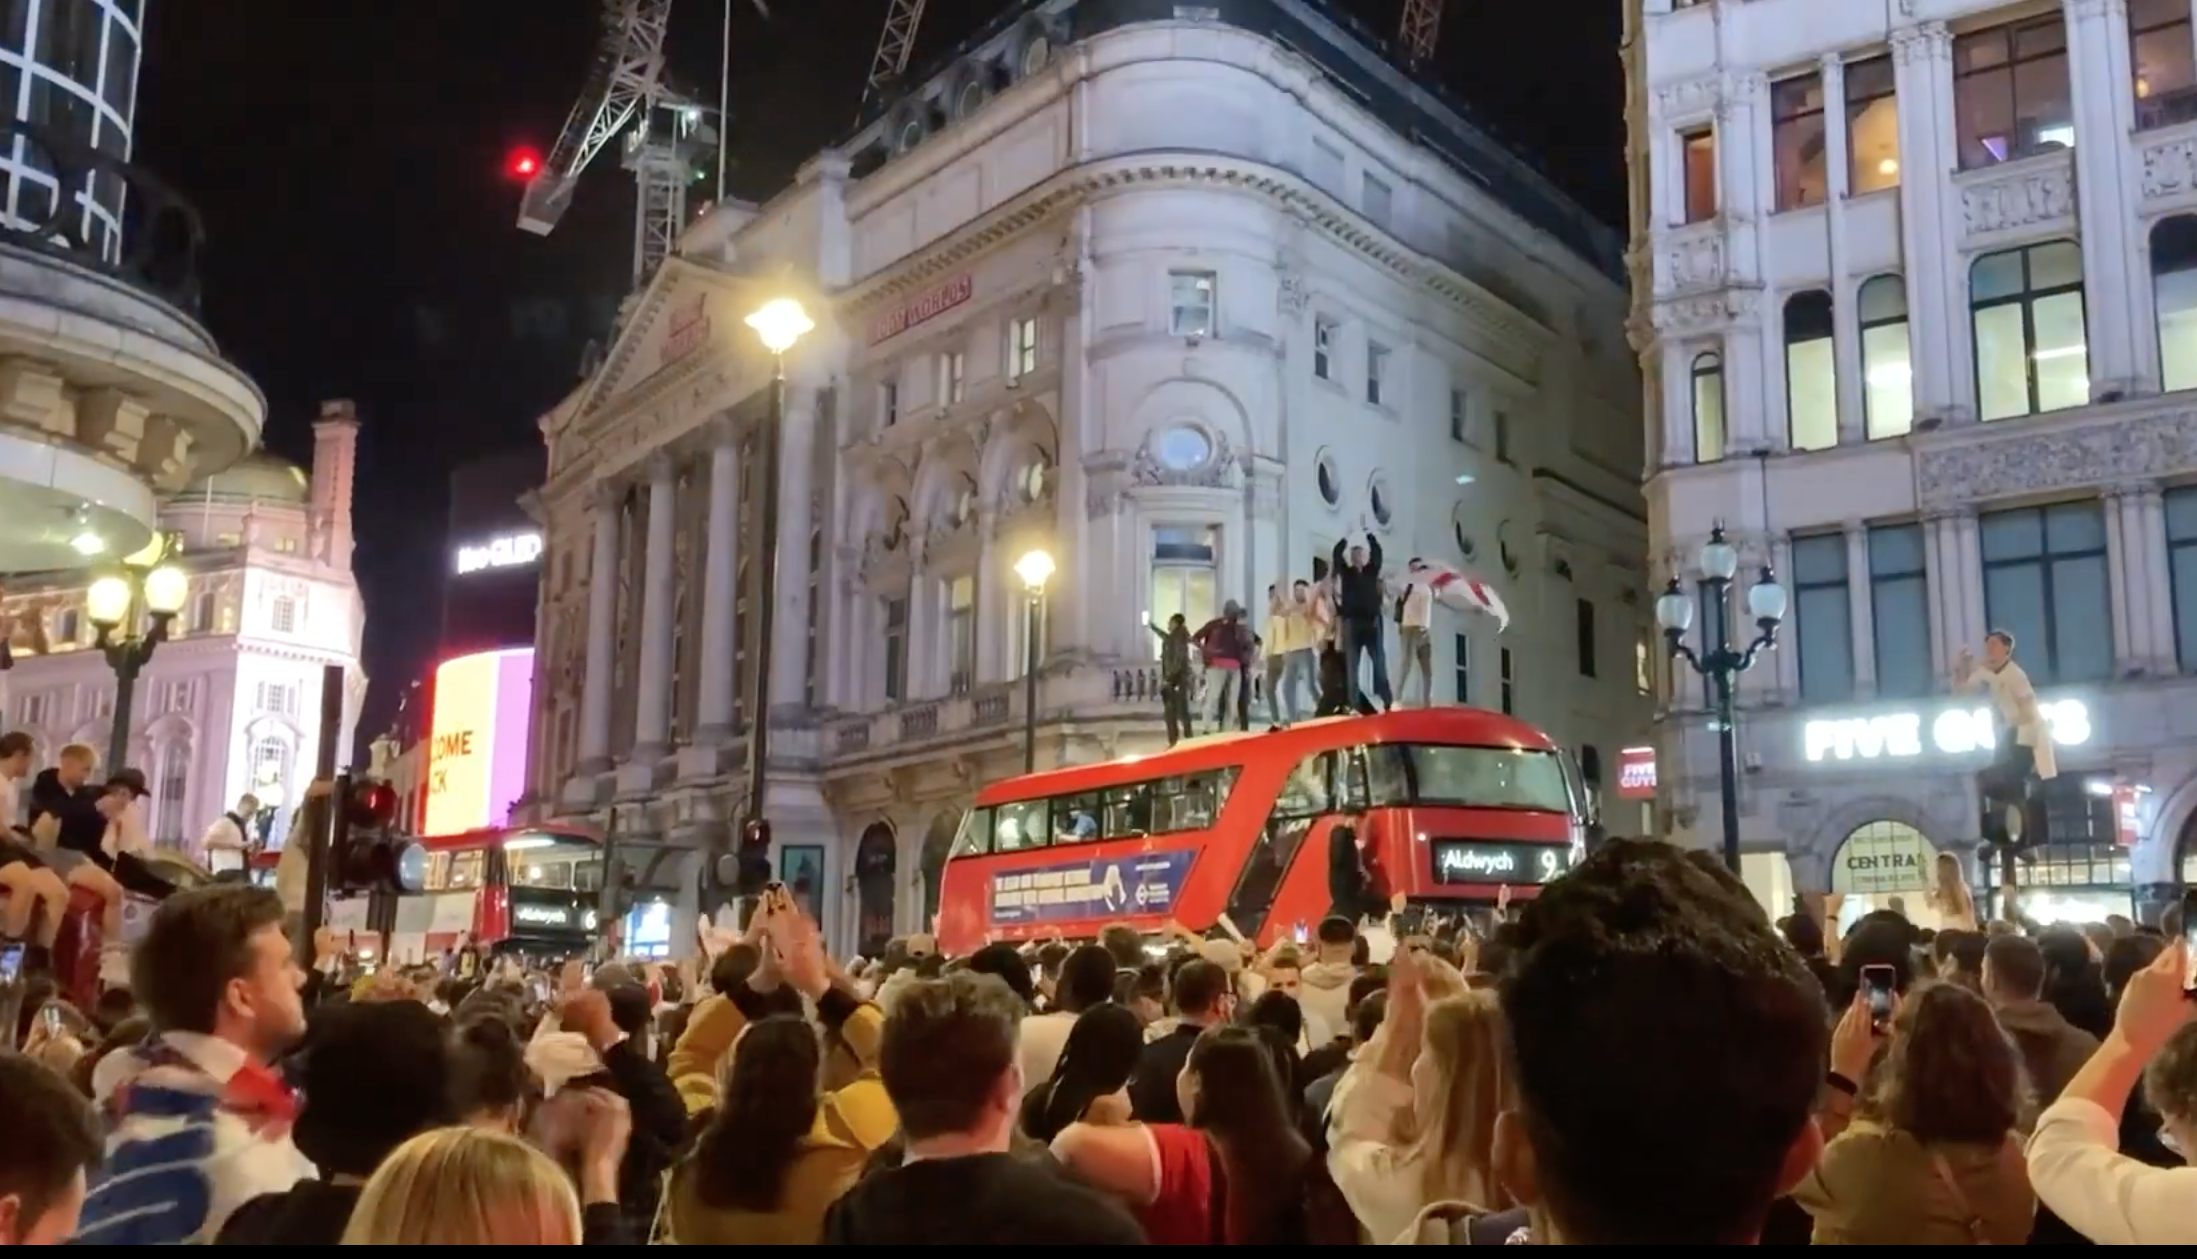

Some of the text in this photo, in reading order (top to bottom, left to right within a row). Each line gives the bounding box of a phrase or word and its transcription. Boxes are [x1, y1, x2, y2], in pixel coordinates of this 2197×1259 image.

[1805, 713, 1922, 761] FIVE
[1623, 762, 1656, 776] FIVE
[1443, 850, 1557, 880] Aldwych 9
[1847, 853, 1926, 870] CENTRA
[584, 910, 597, 931] 6
